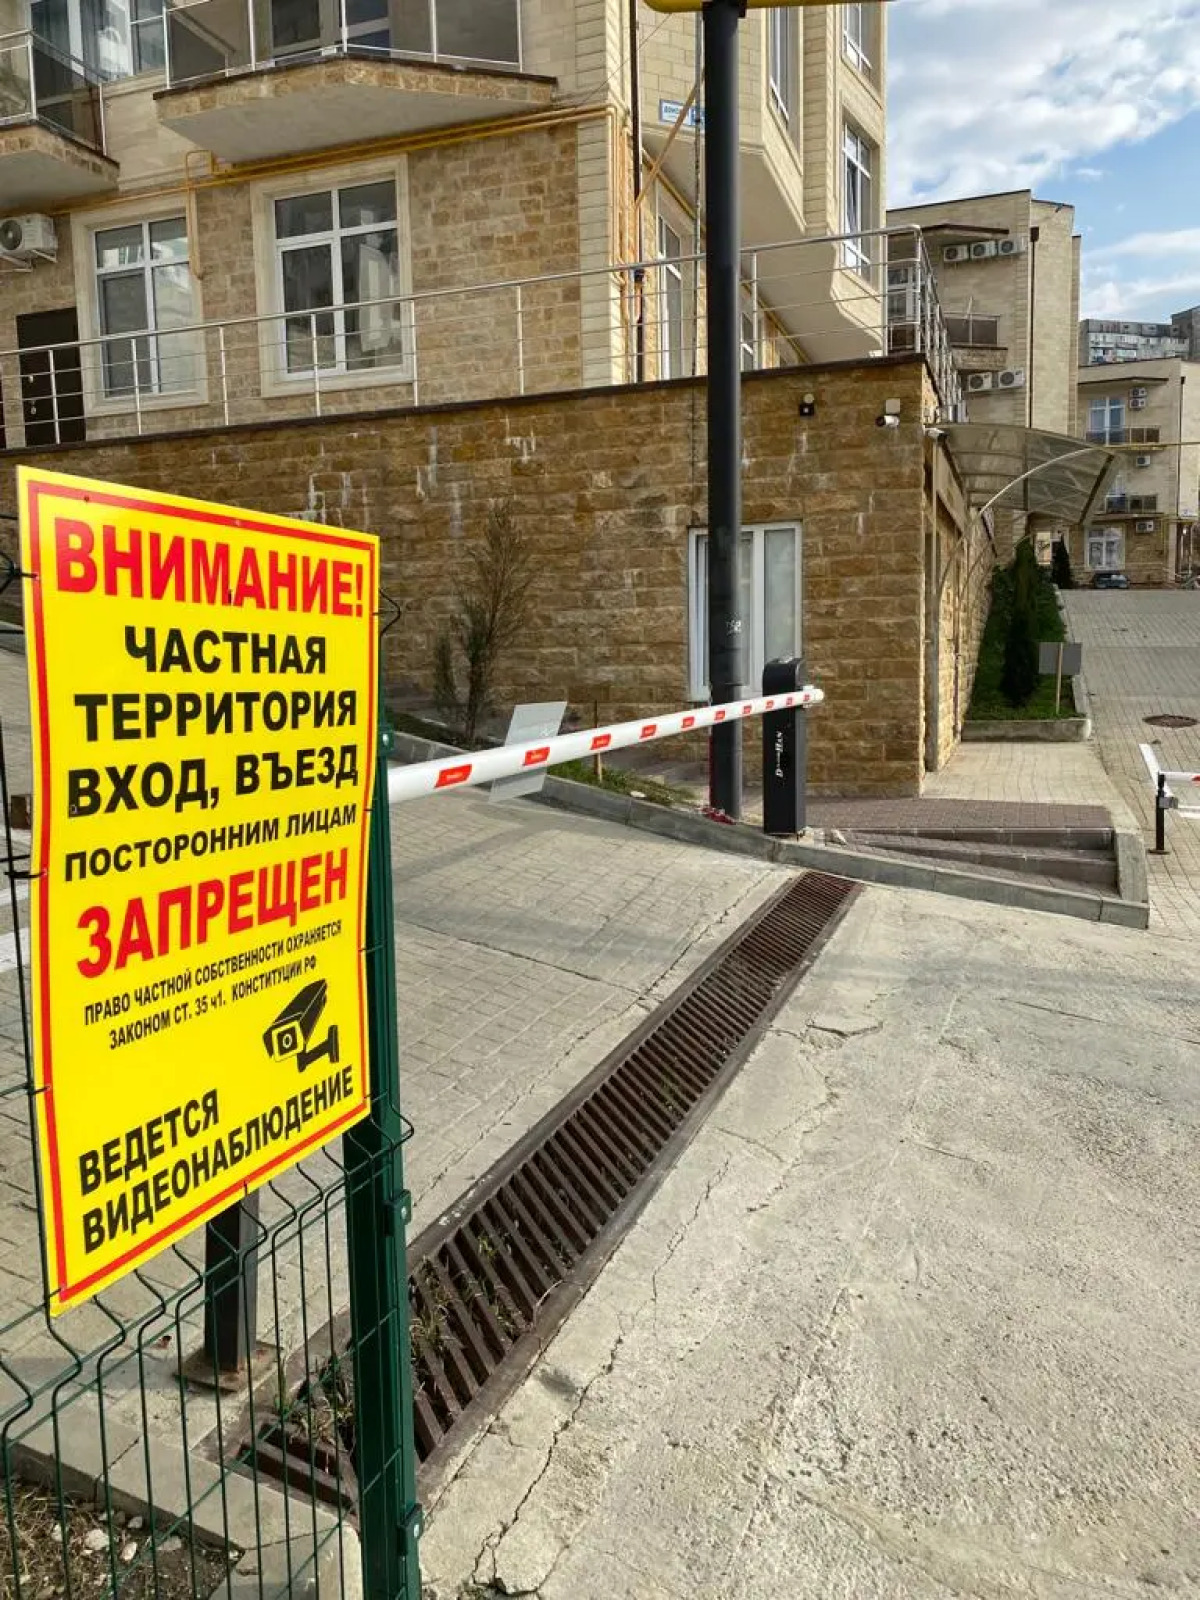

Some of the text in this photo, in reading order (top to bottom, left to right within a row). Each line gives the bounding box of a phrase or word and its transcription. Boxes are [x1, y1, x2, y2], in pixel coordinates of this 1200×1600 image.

[55, 519, 364, 618] ВНИМАНИЕ!
[124, 626, 326, 674] ЧАСТНАЯ
[74, 690, 357, 742] ТЕРРИТОРИЯ
[68, 744, 359, 818] ВХОД, ВЪЕЗД
[65, 804, 357, 882] ПОСТОРОННИМ ЛИЦАМ
[77, 847, 348, 979] ЗАПРЕЩЕН
[84, 919, 343, 1026] ПРАВО ЧАСТНОЙ СОБСТВЕННОСТИ ОХРАНЯЕТСЯ
[109, 1009, 171, 1050] ЗАКОНОМ
[174, 1002, 192, 1025] СТ.
[195, 995, 209, 1016] 35
[231, 961, 302, 1001] КОНСТИТУЦИИ
[303, 954, 317, 973] РФ
[80, 1089, 219, 1196] ВЕДЕТСЯ
[82, 1065, 354, 1255] ВИДЕОНАБЛЮДЕНИЕ
